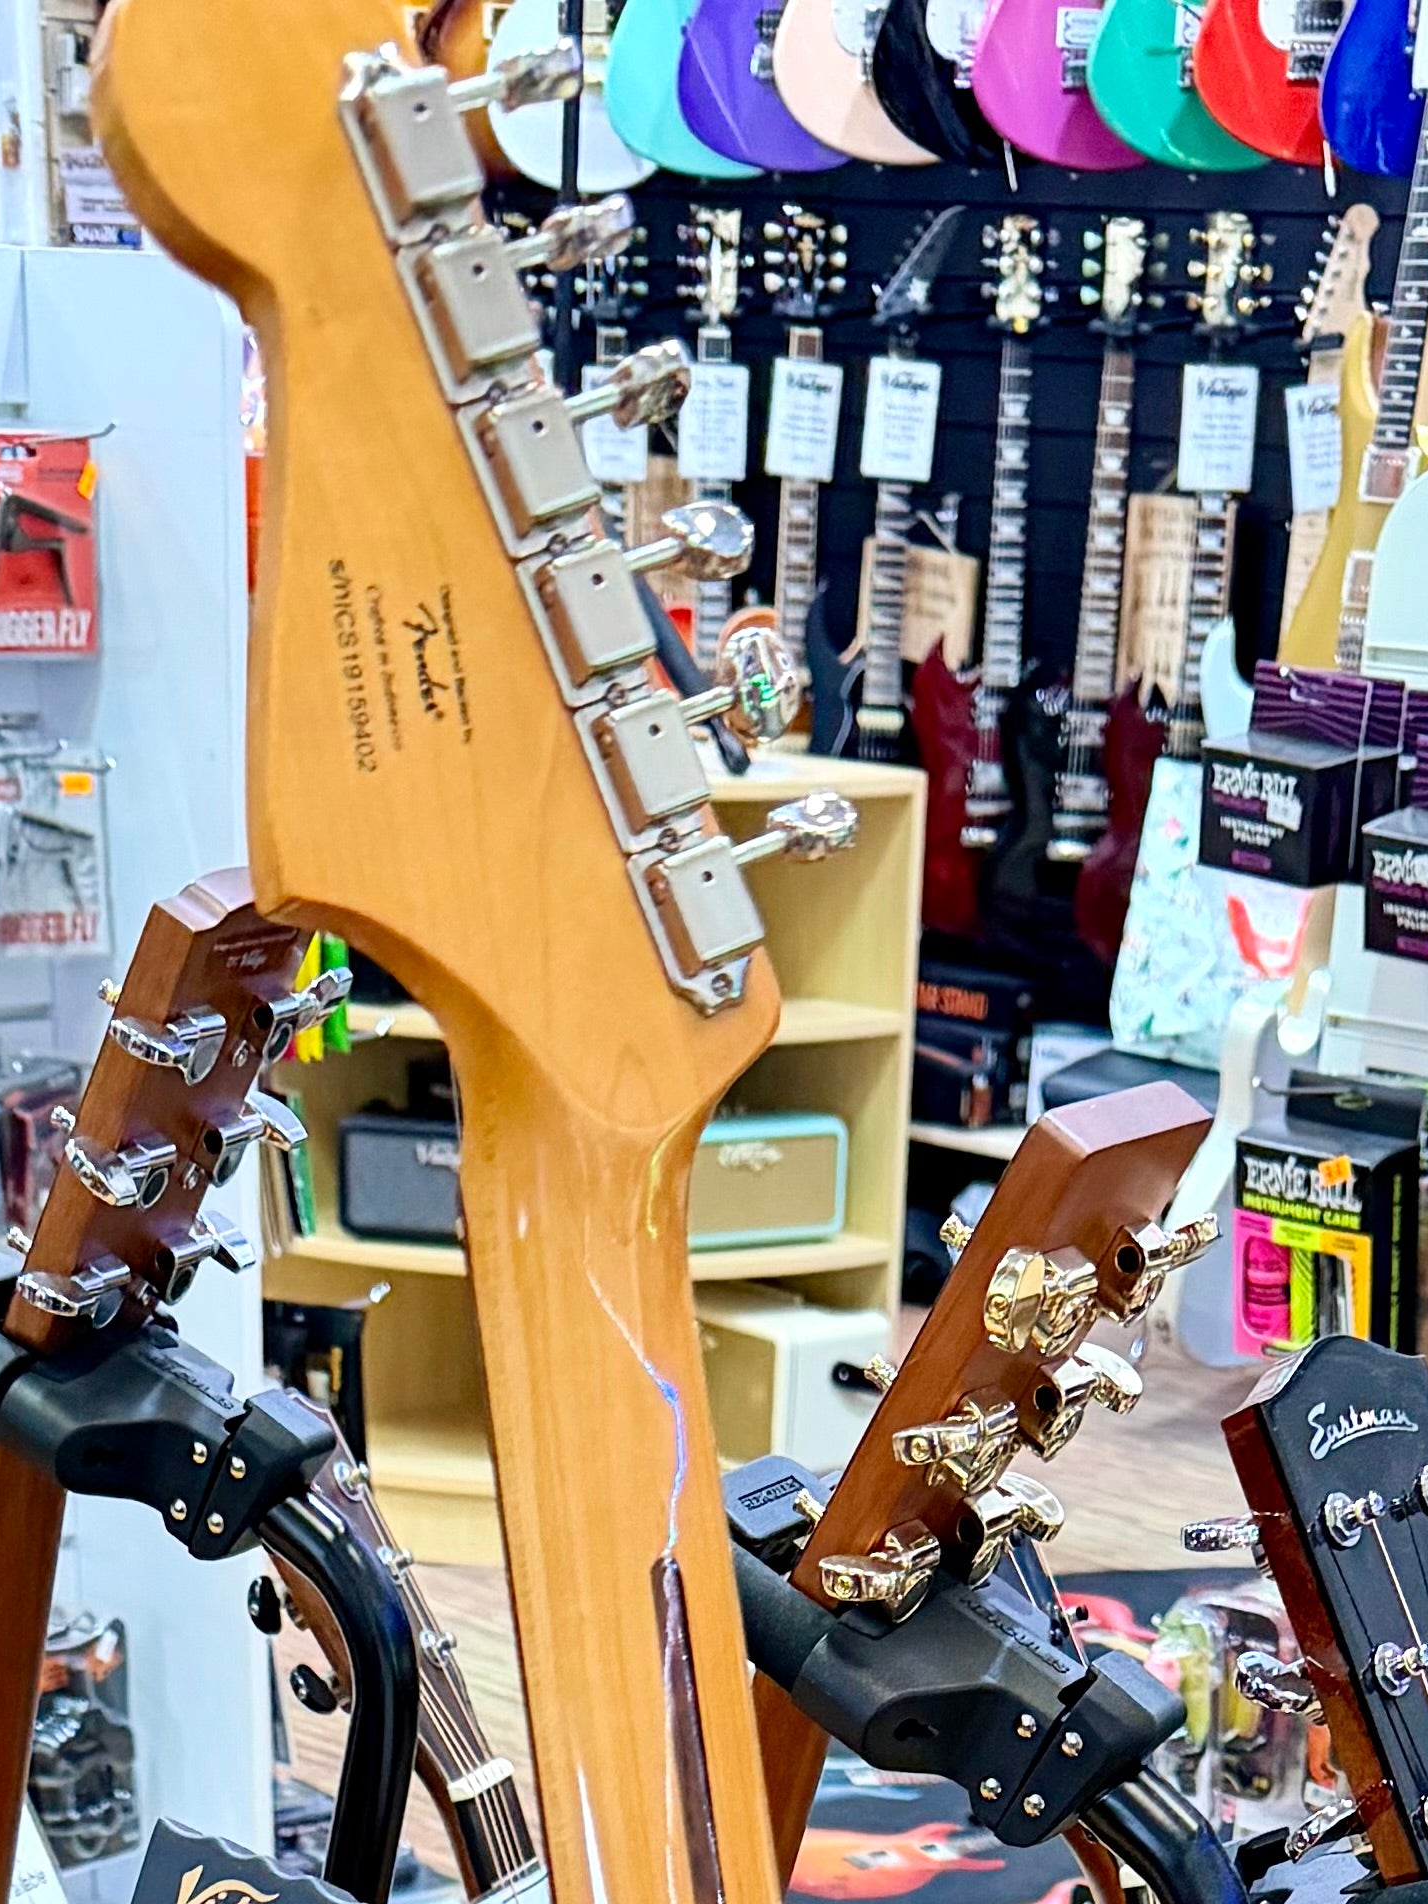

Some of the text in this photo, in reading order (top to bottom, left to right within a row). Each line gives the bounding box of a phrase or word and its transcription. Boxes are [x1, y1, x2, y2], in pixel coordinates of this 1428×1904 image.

[402, 602, 449, 712] Fender
[1243, 1156, 1311, 1200] ERNIE
[1307, 1401, 1420, 1461] Eastman
